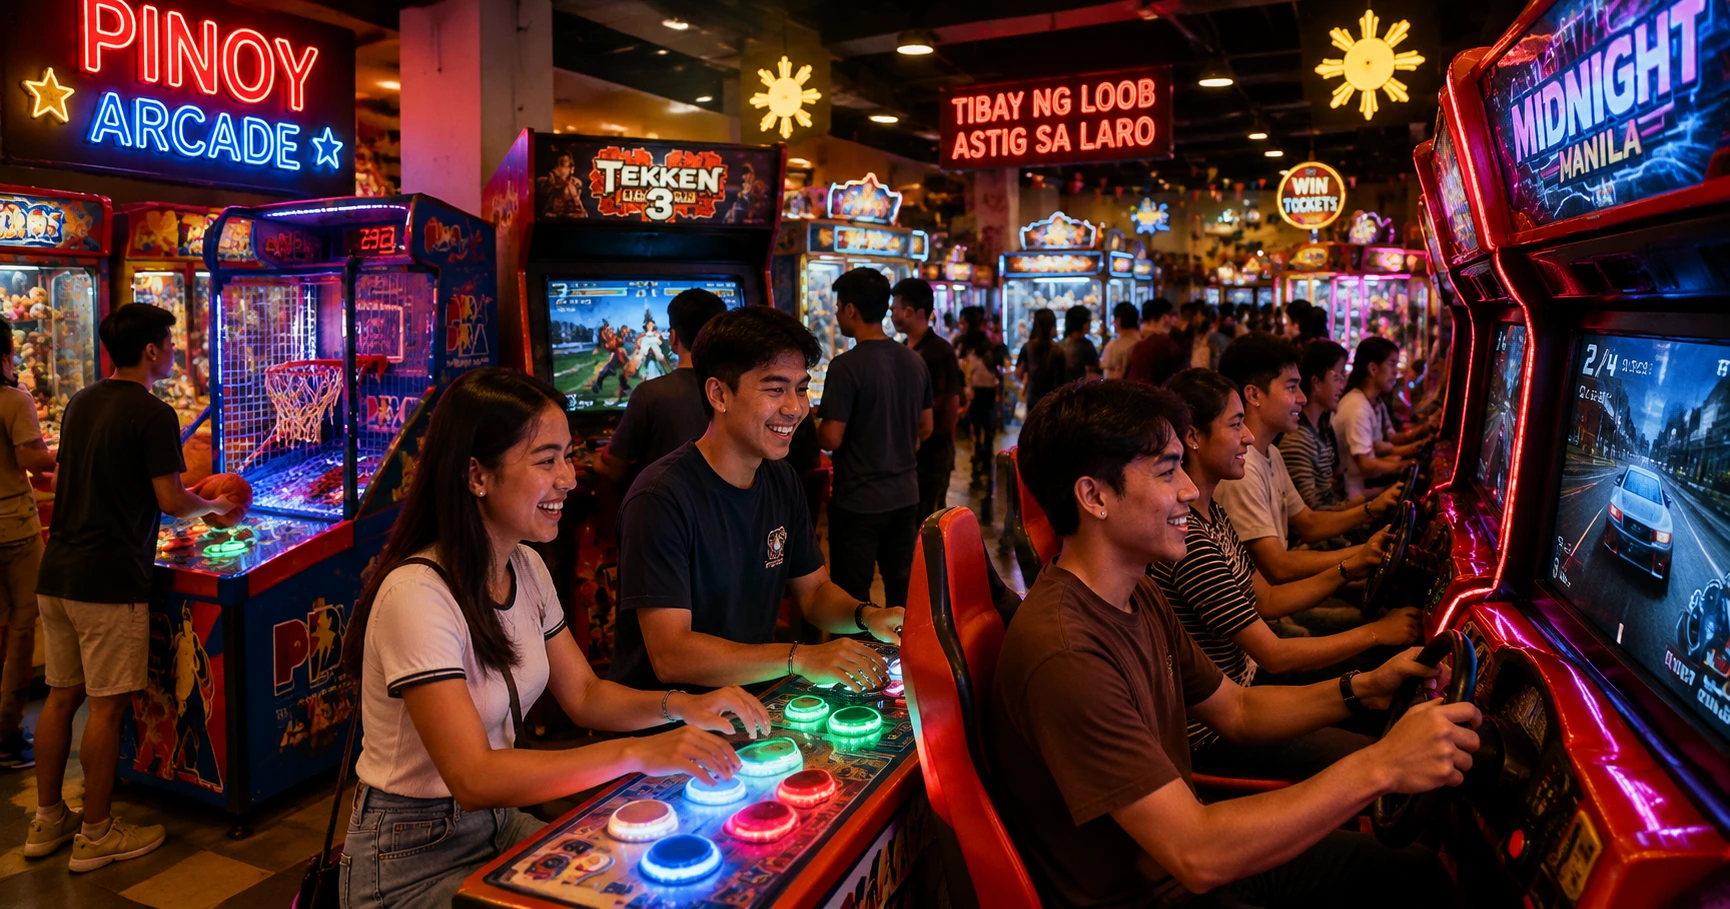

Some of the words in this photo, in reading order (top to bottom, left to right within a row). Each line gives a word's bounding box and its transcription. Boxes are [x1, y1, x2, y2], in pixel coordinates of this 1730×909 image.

[83, 0, 318, 112] PINOY
[951, 90, 1024, 125] TIBAY
[1033, 87, 1071, 118] NG
[1081, 78, 1156, 113] LOOB
[1511, 0, 1706, 164] MIDNIGHT
[91, 92, 301, 171] ARCADE
[951, 127, 1028, 160] ASTIG
[1035, 123, 1071, 153] SA
[1080, 116, 1156, 150] LARO
[1559, 118, 1642, 184] MANILA
[595, 159, 724, 195] TEKKEN
[1291, 176, 1329, 195] WIN
[645, 187, 674, 220] 3
[1582, 344, 1618, 378] 2/4
